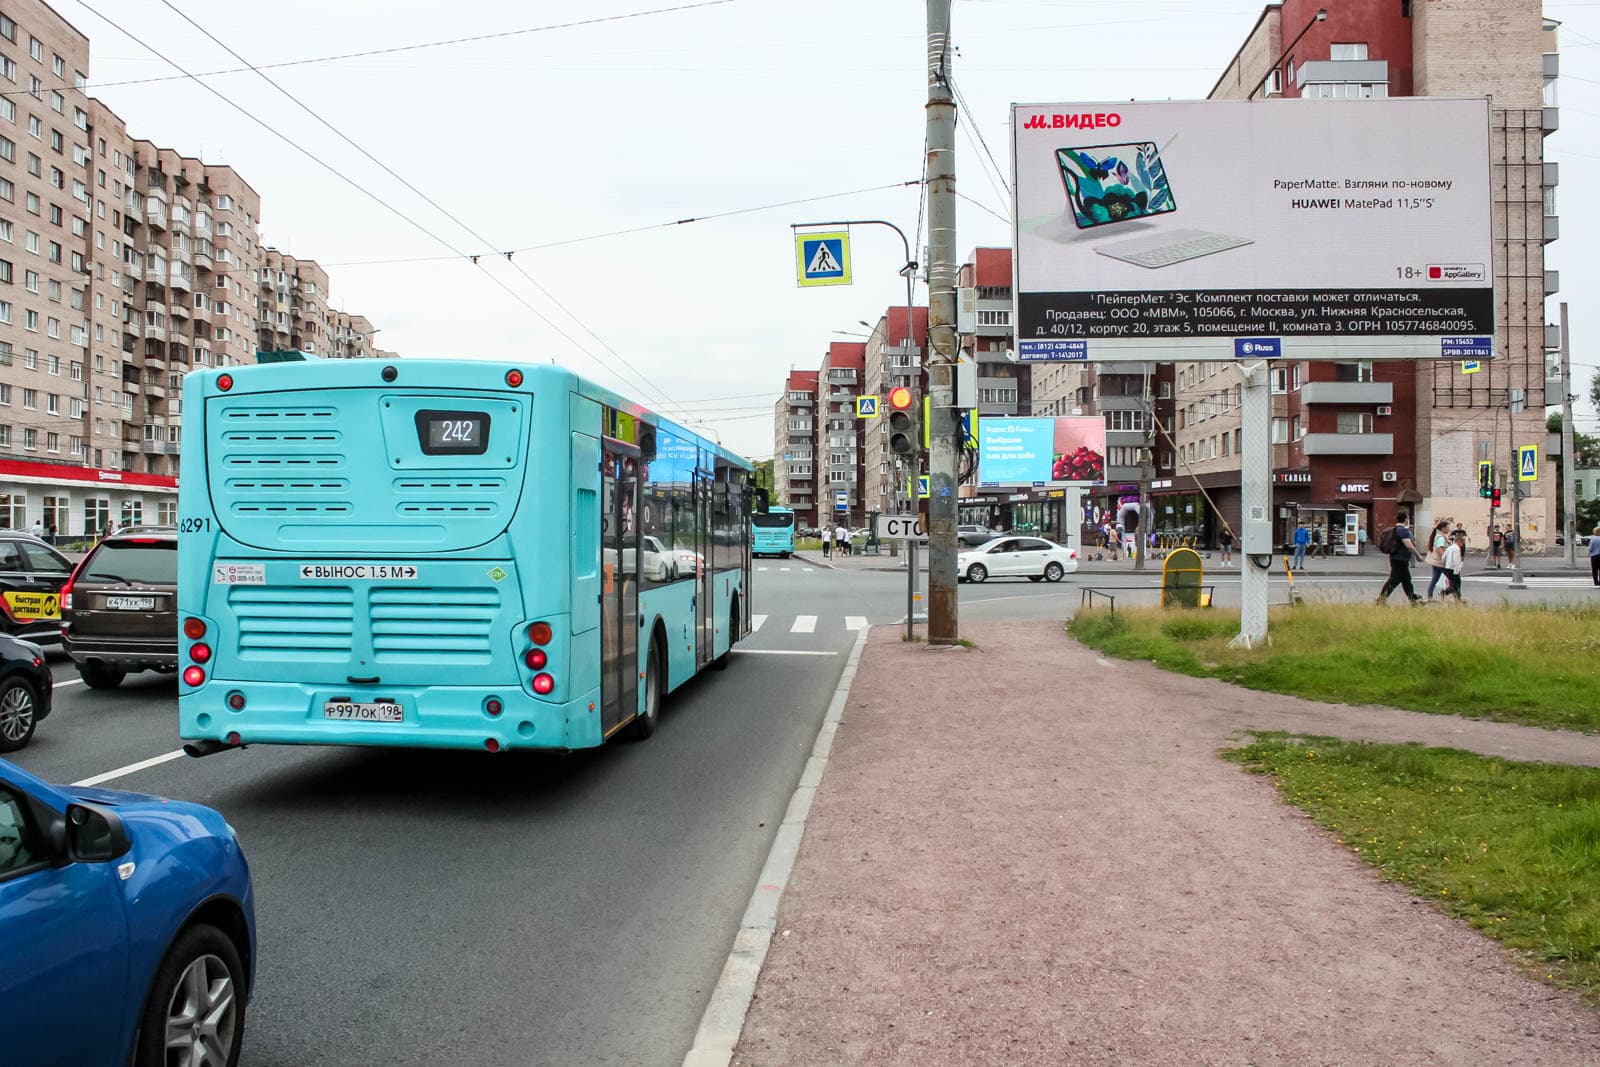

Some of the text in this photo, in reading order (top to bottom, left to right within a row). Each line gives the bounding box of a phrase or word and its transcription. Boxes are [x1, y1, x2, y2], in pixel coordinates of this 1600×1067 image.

[1344, 179, 1388, 189] Взгляни
[1392, 180, 1452, 190] по-новому
[1291, 199, 1340, 209] HUAWEI
[1344, 199, 1392, 208] MatePad
[1396, 267, 1422, 278] 18+
[1444, 271, 1481, 279] AppGallery
[1196, 293, 1252, 303] Комплект
[1256, 293, 1309, 302] поставки
[1313, 293, 1350, 302] может
[1353, 293, 1421, 302] отличаться.
[1046, 305, 1467, 321] Продавец: ООО «МВМ», 105066, г. Москва, ул. Нижняя Красносельская,
[1036, 325, 1047, 335] д.
[1050, 323, 1086, 336] 40/12,
[1089, 324, 1129, 335] корпус
[1133, 323, 1150, 335] 20,
[1153, 324, 1181, 333] этаж
[1184, 322, 1194, 334] 5,
[1197, 322, 1265, 333] помещение
[1282, 322, 1332, 331] комната
[1335, 321, 1345, 331] 3.
[1348, 320, 1381, 331] ОГРН
[1385, 320, 1477, 331] 1057746840095.
[442, 420, 473, 441] 242
[1347, 484, 1370, 492] МТС
[180, 517, 210, 533] 6291
[315, 566, 404, 578] ВЫНОС 1.5 М
[380, 705, 399, 716] 198
